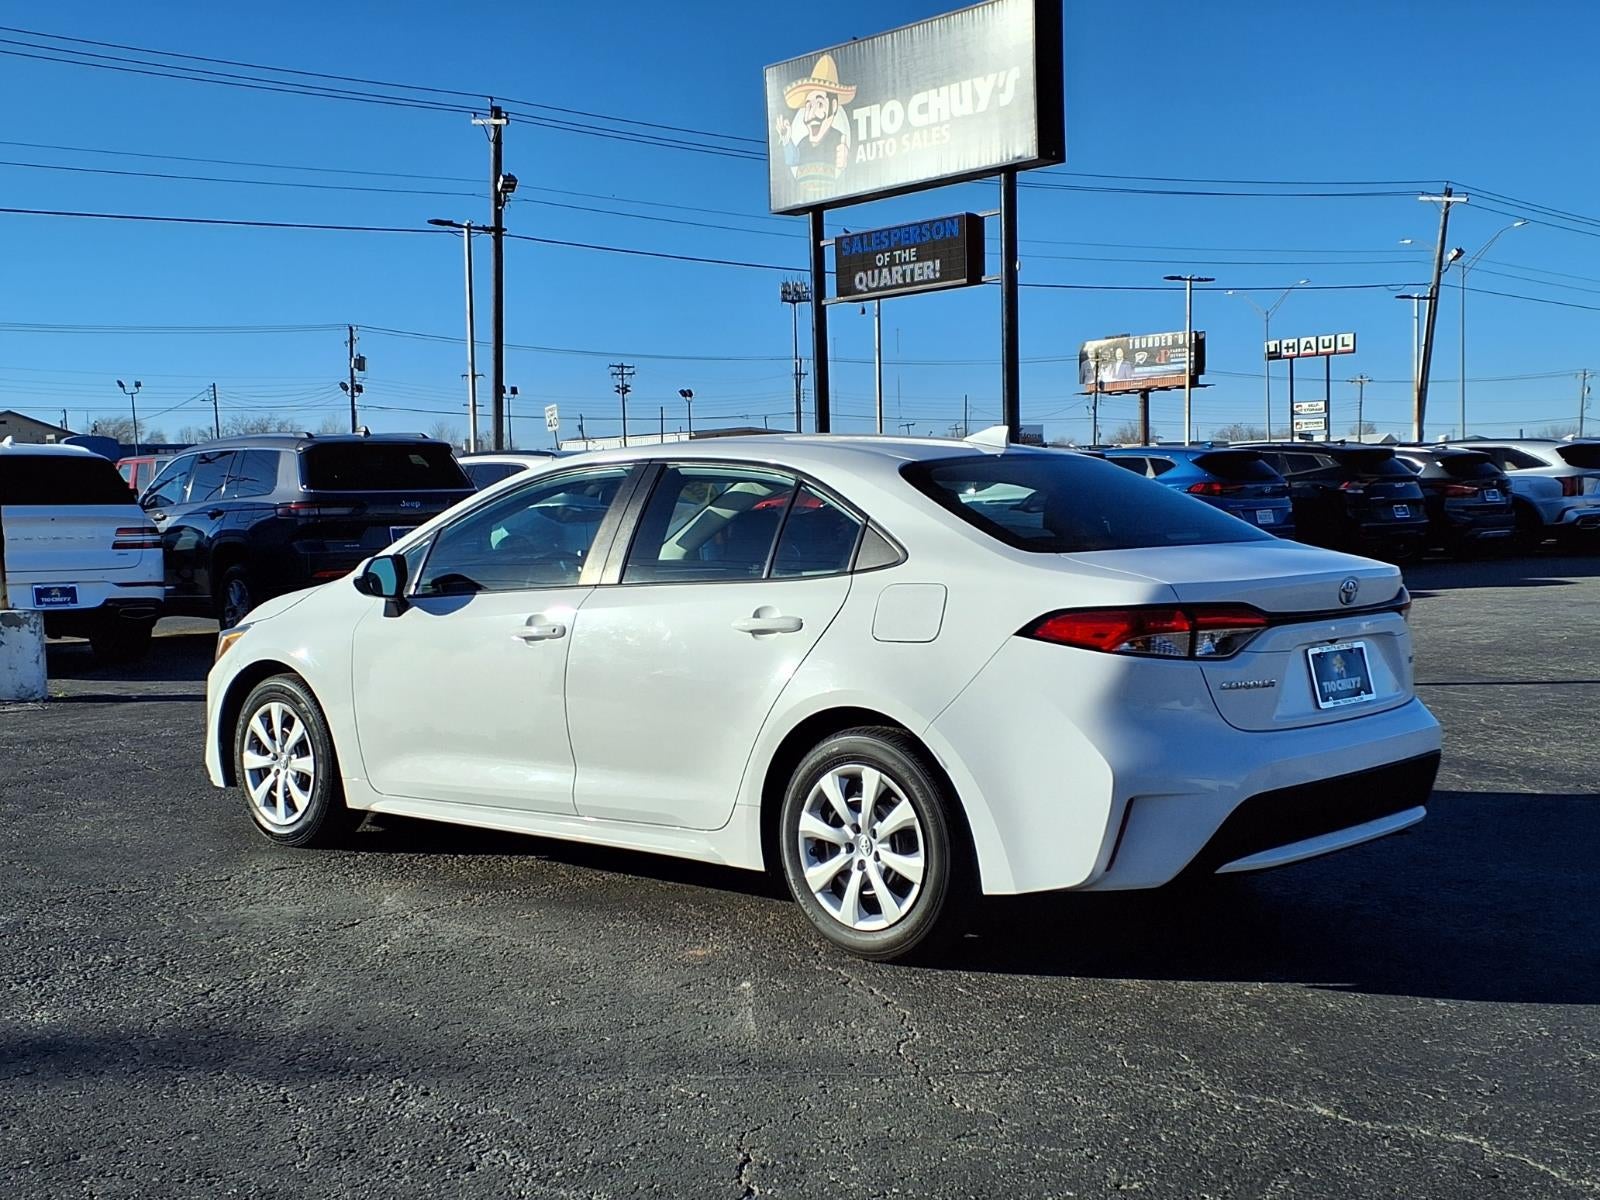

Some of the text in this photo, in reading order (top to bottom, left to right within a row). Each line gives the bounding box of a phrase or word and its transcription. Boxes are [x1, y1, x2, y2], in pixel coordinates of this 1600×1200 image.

[853, 66, 1020, 141] TIO CHUY'S
[856, 124, 950, 164] AUTO SALES
[841, 218, 959, 256] SALESPERSON
[875, 247, 917, 267] OF THE
[854, 259, 940, 292] QUARTER!
[1128, 335, 1173, 350] THUNDER
[547, 416, 558, 427] 40
[400, 500, 421, 508] Jeep
[1322, 681, 1337, 693] TIO
